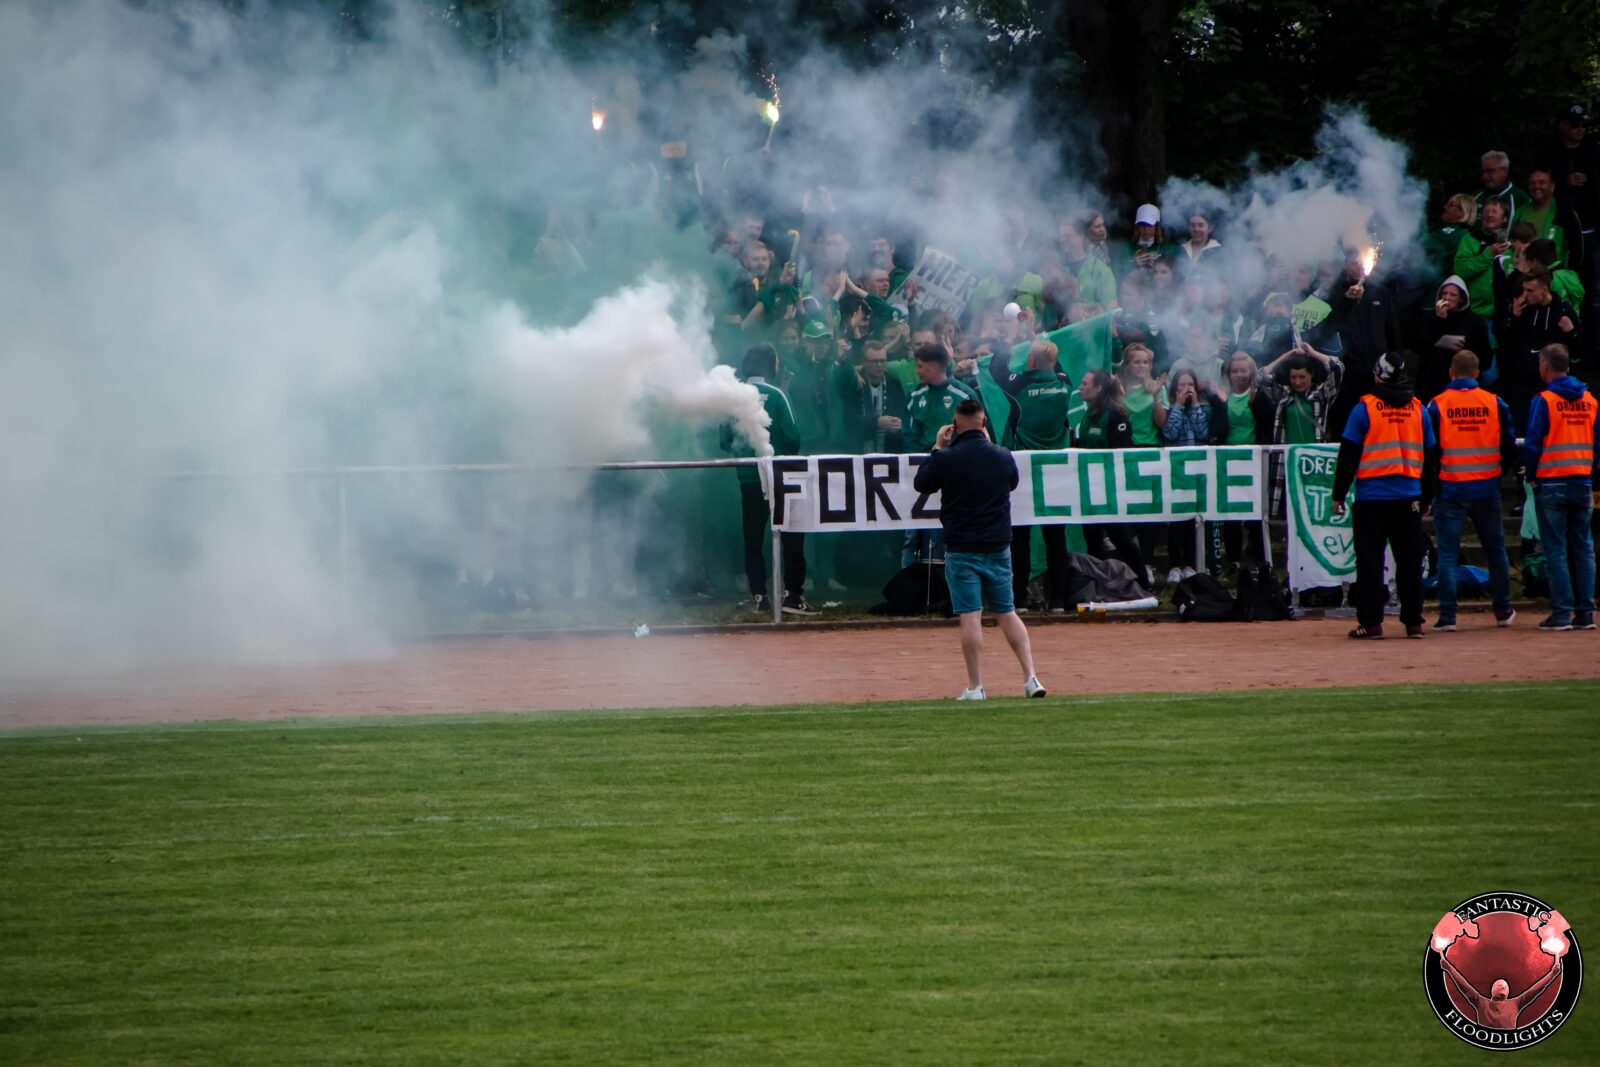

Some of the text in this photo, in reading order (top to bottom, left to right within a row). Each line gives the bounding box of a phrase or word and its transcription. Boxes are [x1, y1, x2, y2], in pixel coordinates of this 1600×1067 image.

[1447, 406, 1489, 418] ORDNER
[1557, 402, 1591, 411] ORDNER
[1300, 454, 1335, 475] DRE
[772, 449, 1253, 525] FORZ COSSE
